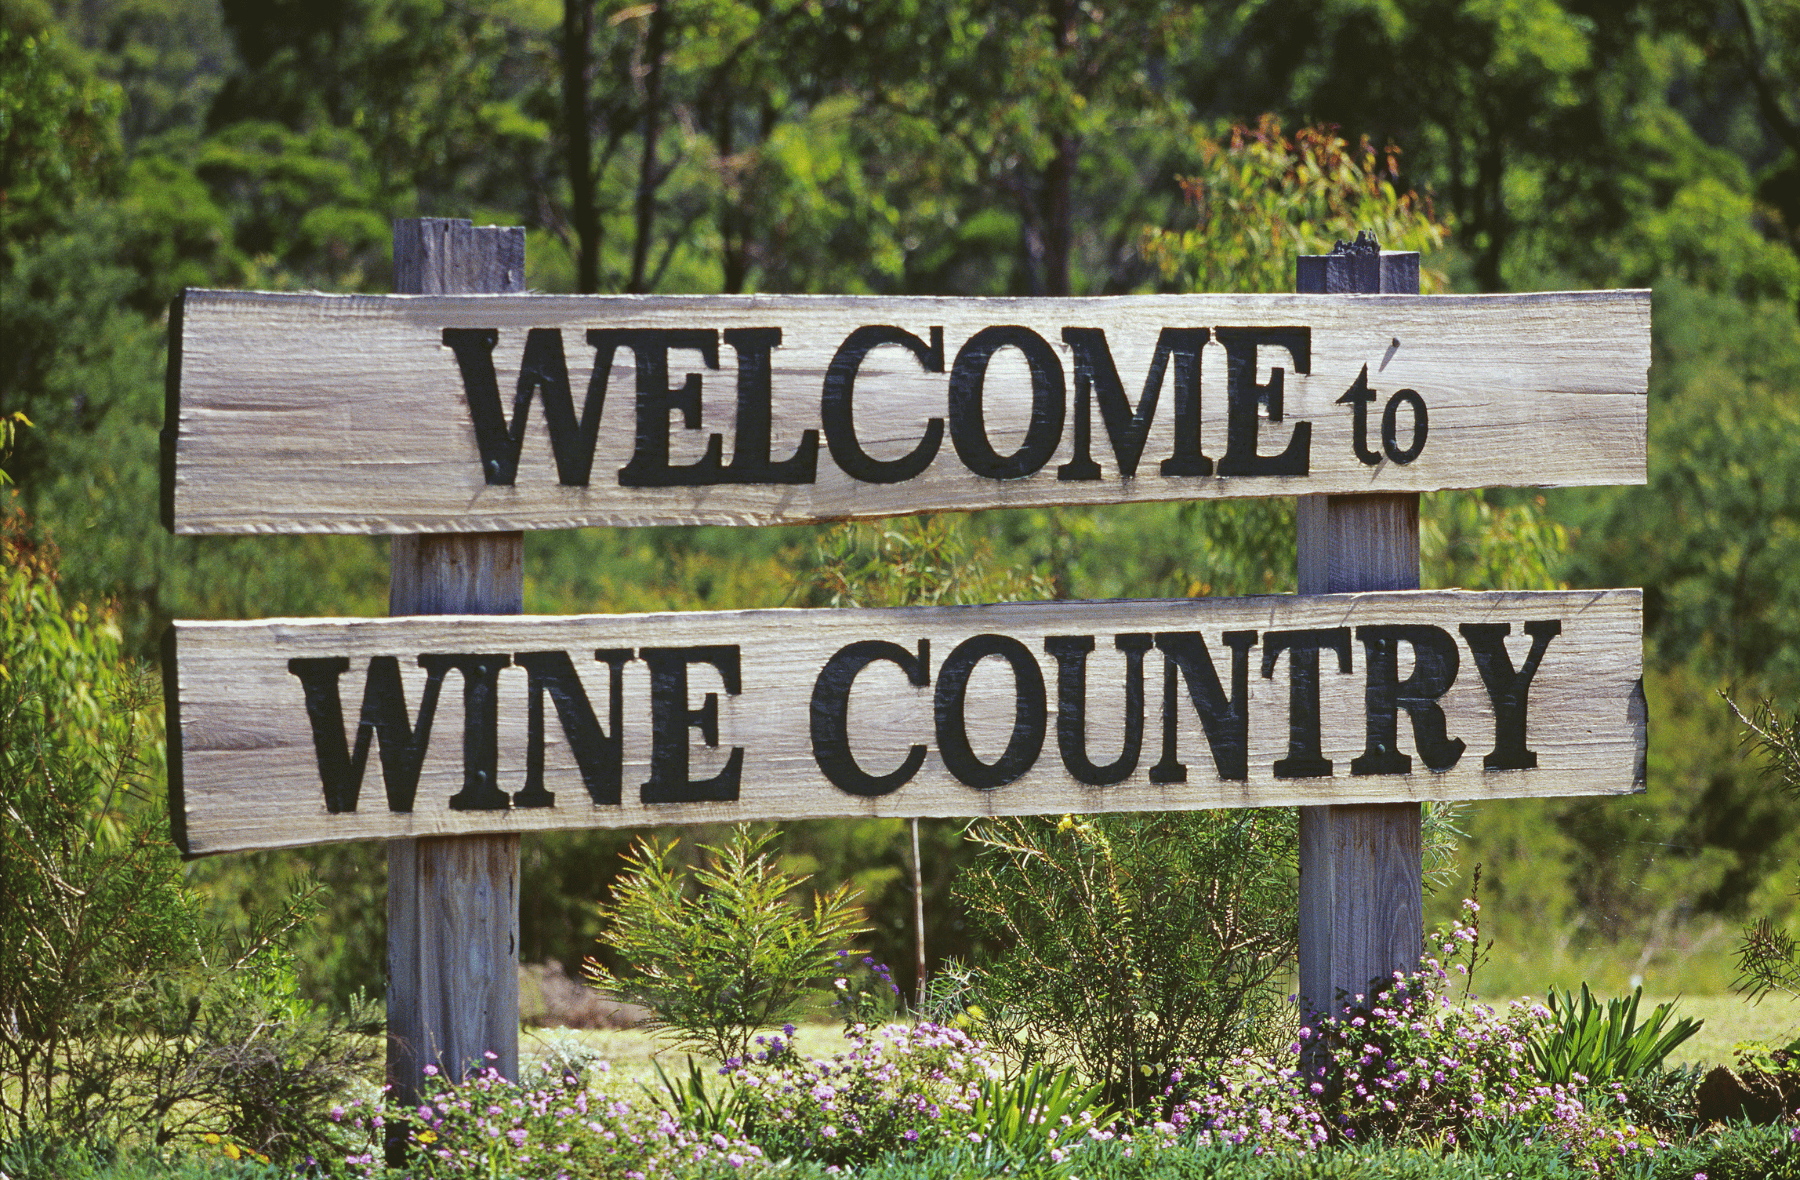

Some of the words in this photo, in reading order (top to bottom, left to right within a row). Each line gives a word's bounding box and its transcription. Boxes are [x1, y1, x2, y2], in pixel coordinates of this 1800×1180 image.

[443, 325, 1311, 489] WELCOME
[1336, 363, 1429, 466] to
[288, 644, 744, 814] WINE
[810, 619, 1562, 799] COUNTRY
